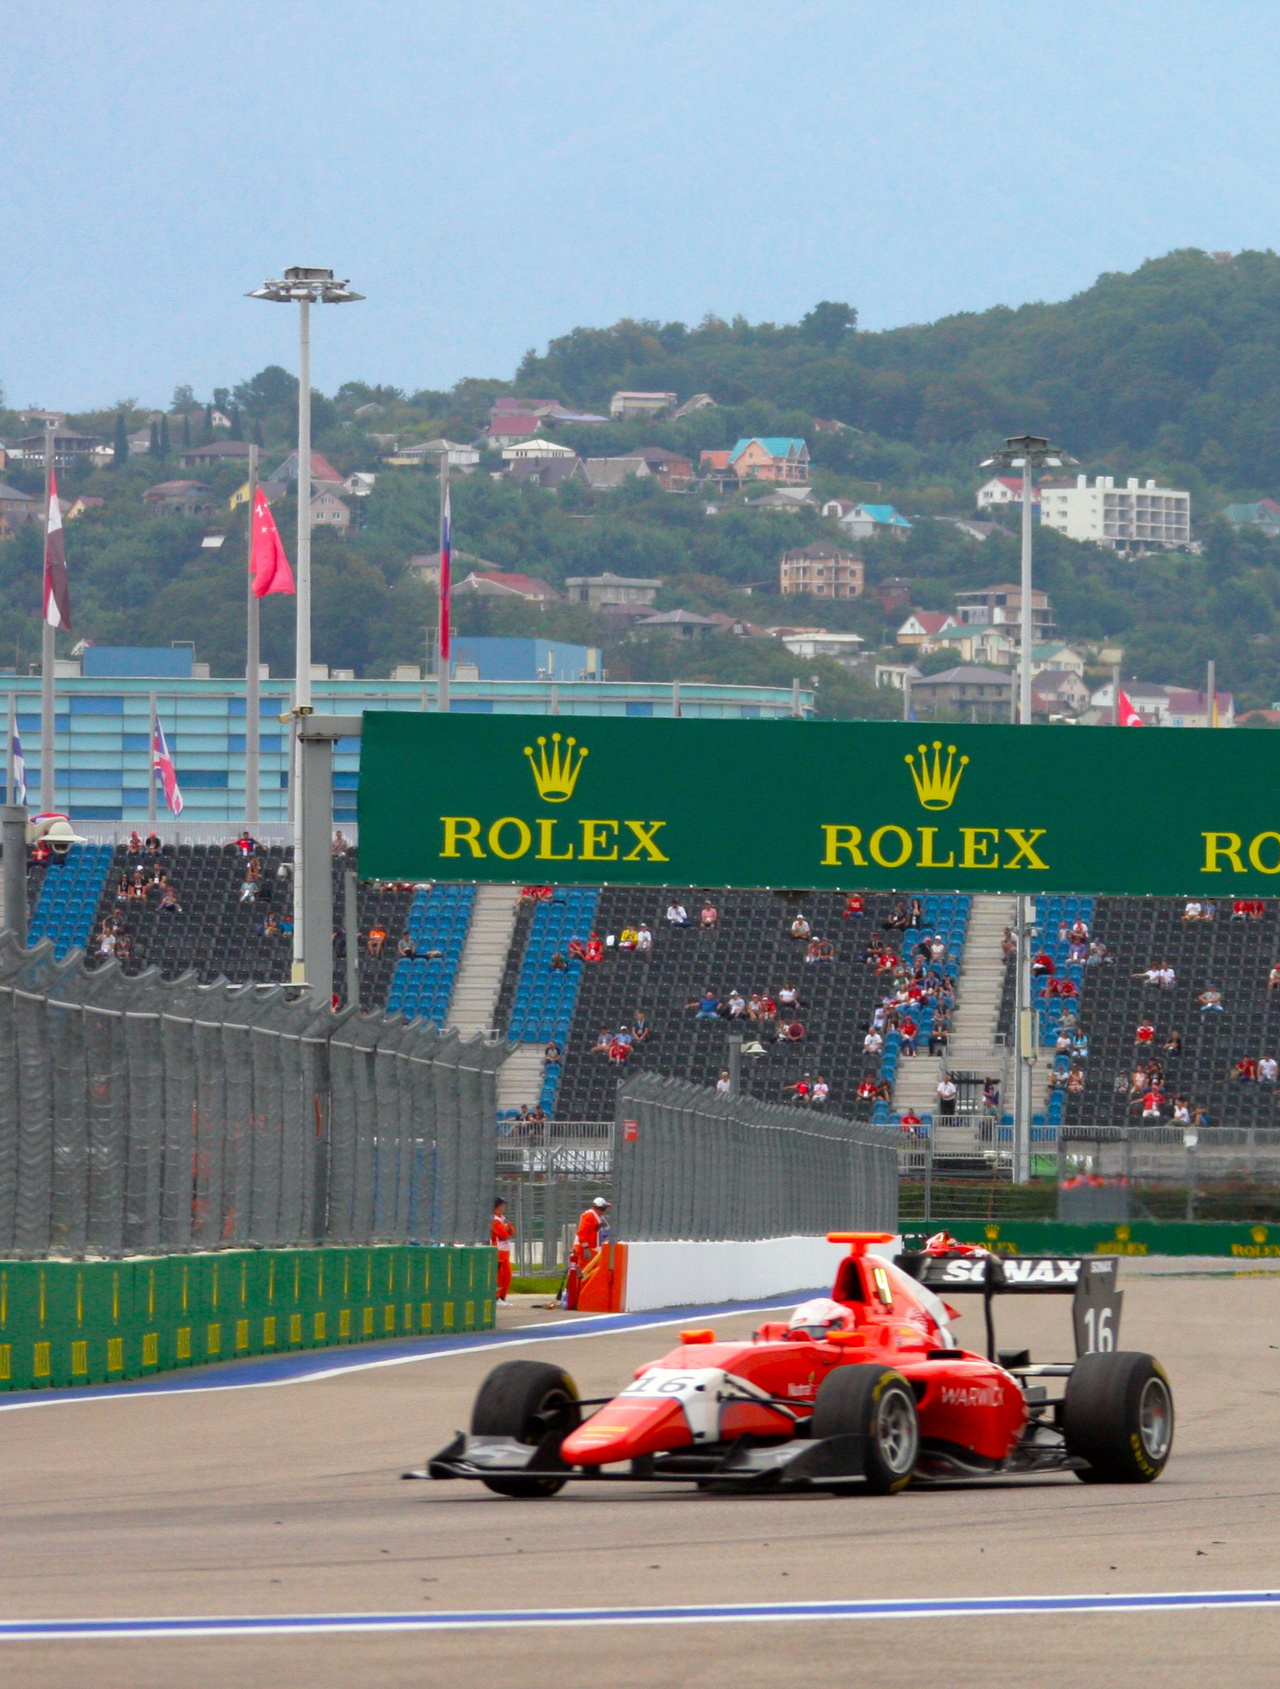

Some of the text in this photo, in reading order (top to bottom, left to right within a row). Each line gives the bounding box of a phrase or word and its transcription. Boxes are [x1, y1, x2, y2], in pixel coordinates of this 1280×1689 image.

[439, 816, 670, 862] ROLEX
[820, 824, 1050, 870] ROLEX
[1084, 1307, 1114, 1354] 16
[622, 1376, 695, 1393] 16
